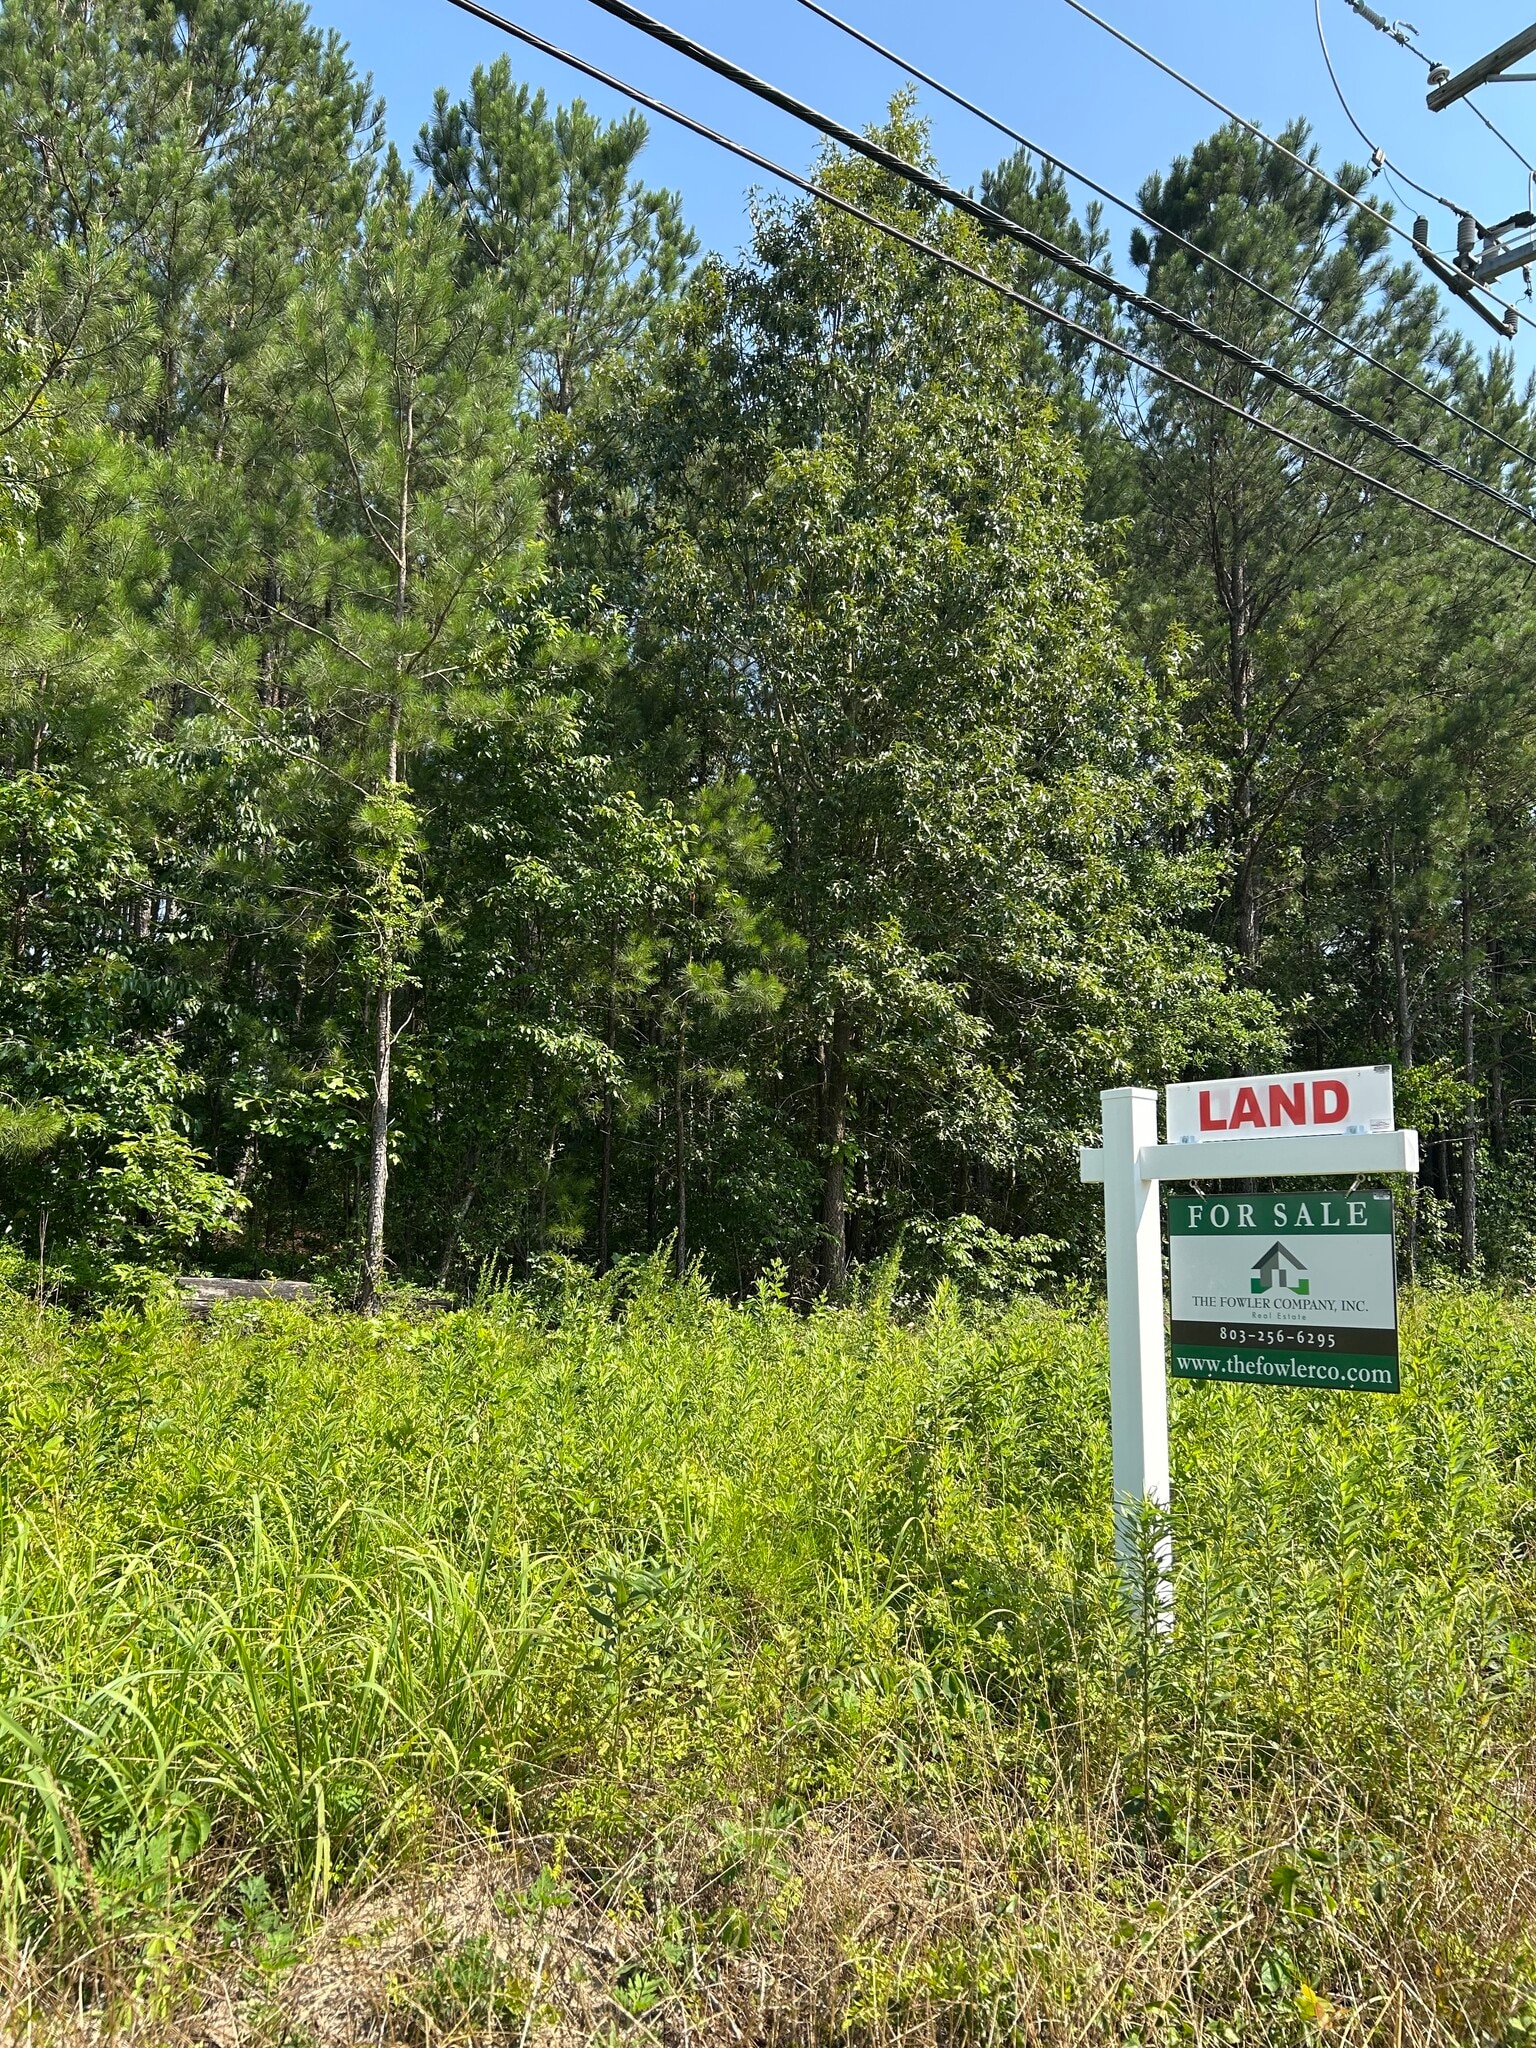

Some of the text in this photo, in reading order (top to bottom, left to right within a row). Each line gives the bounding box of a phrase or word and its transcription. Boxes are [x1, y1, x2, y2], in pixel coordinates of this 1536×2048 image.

[1199, 1080, 1350, 1131] LAND
[1188, 1201, 1368, 1228] FOR SALE
[1192, 1296, 1369, 1312] THE FOWLER COMPANY, INC.
[1252, 1312, 1307, 1321] Real Estate
[1219, 1327, 1336, 1348] 803-256-6295
[1176, 1355, 1393, 1384] www.thefowlerco.com
